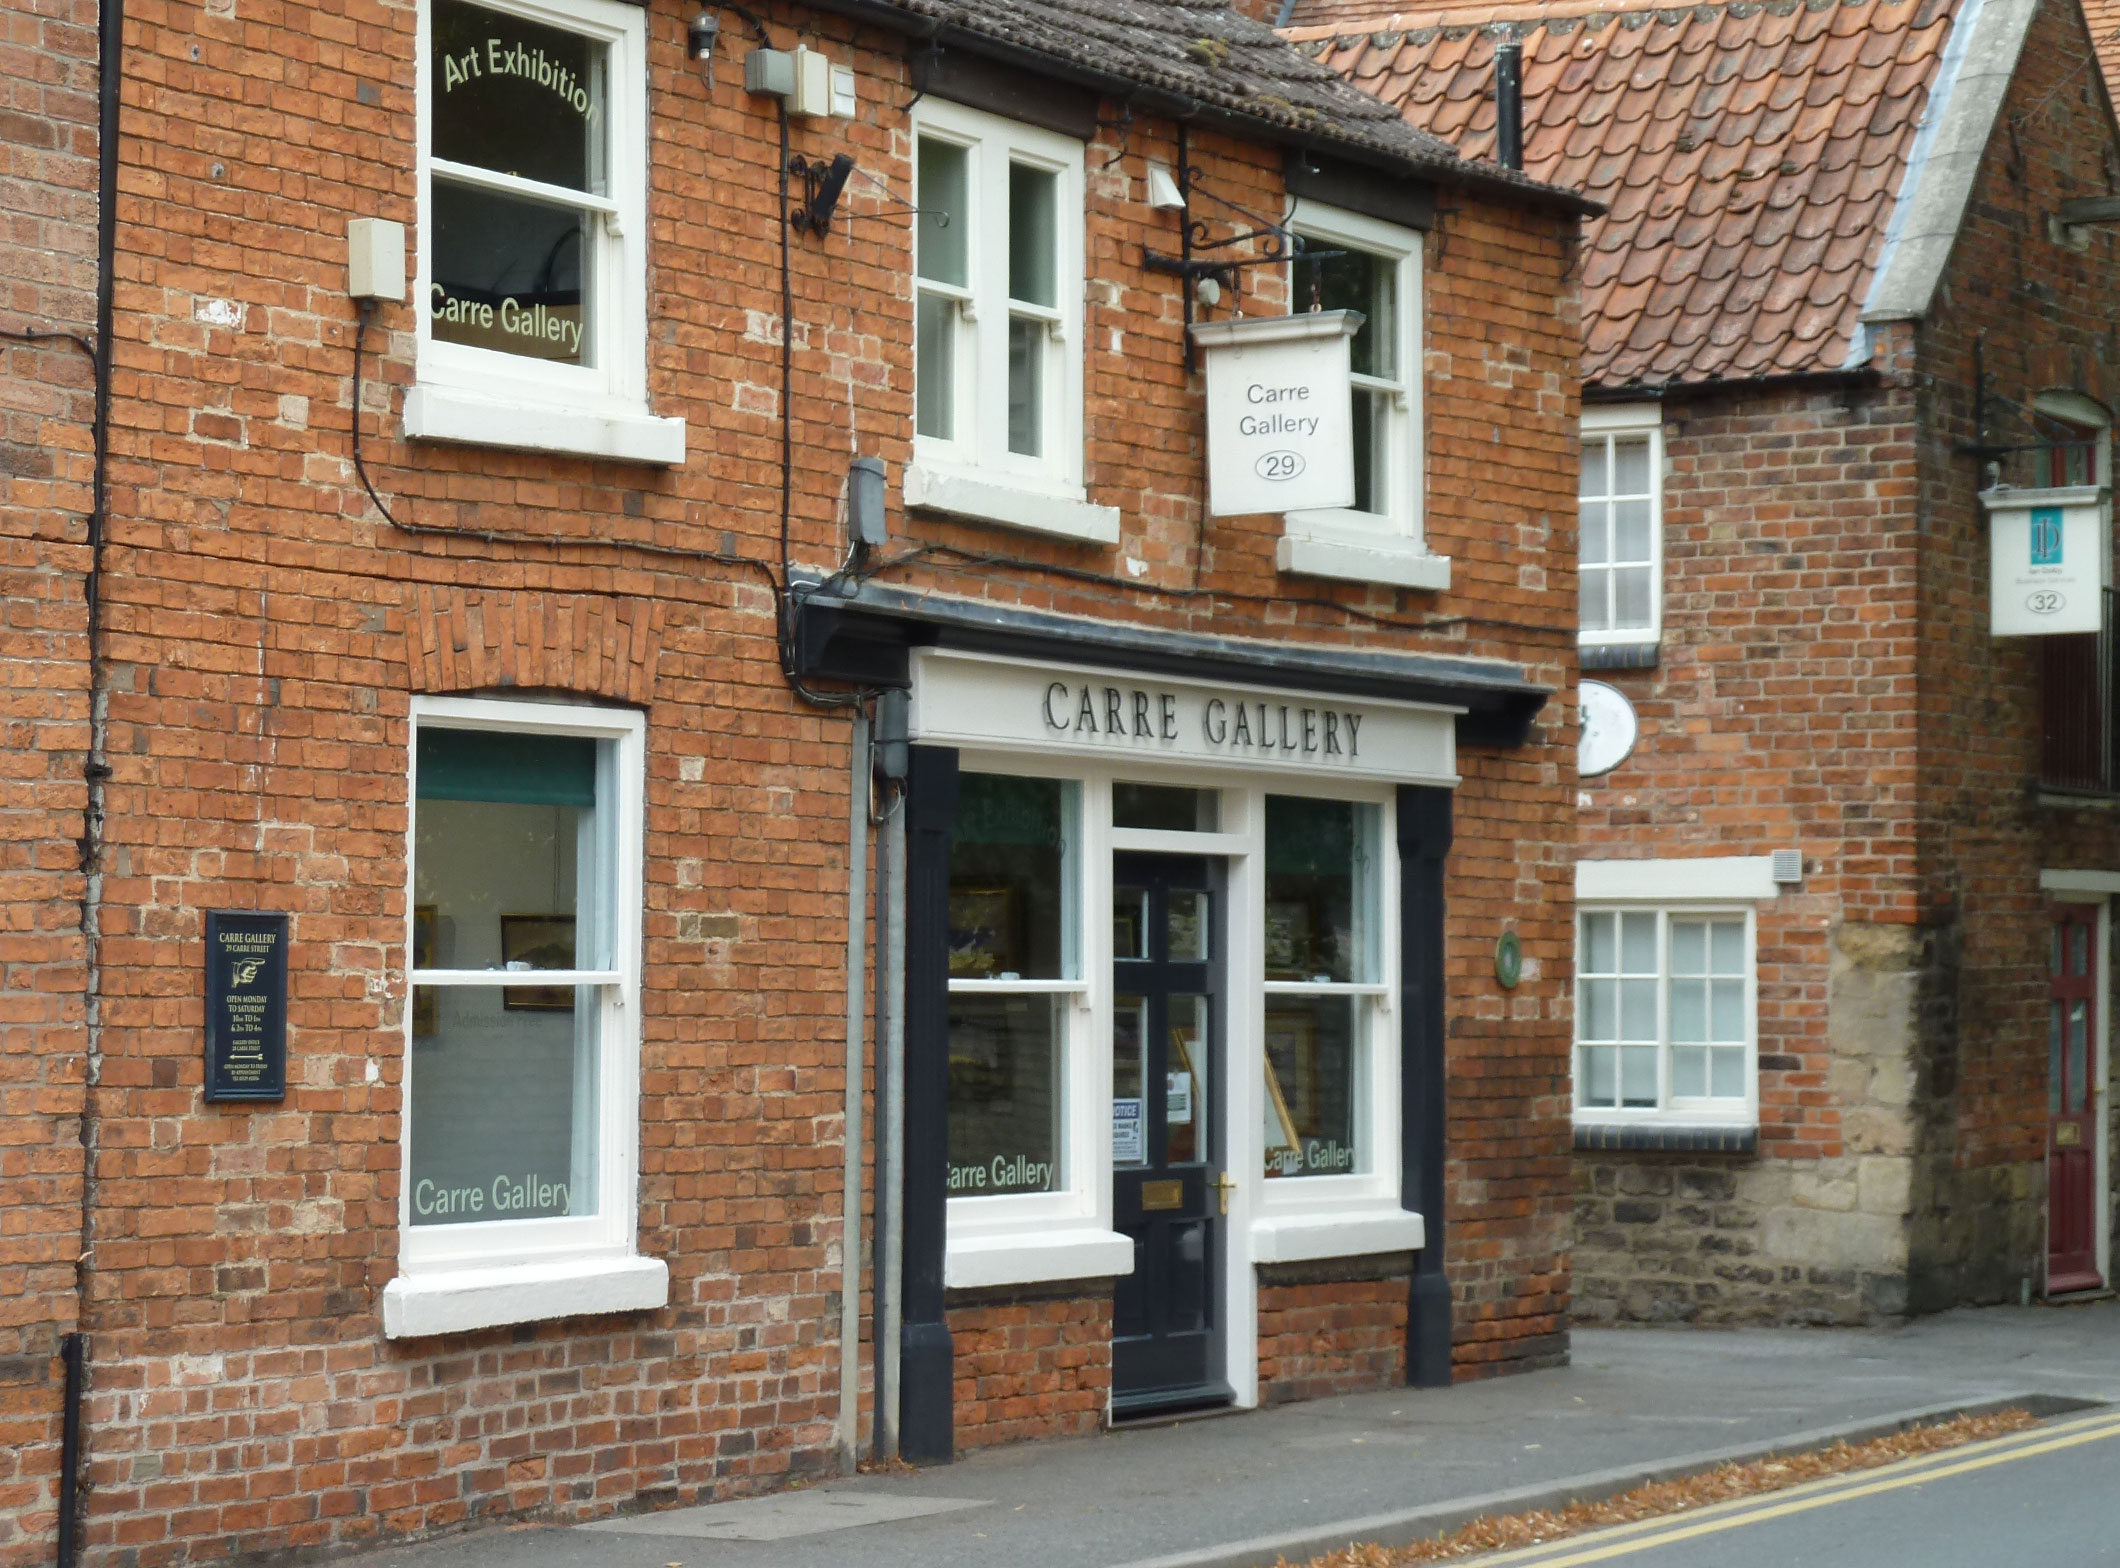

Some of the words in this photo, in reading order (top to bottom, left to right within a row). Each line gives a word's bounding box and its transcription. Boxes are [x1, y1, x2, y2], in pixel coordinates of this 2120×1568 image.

[444, 45, 482, 93] Art
[488, 38, 599, 129] Exhibition
[430, 282, 494, 329] Carre
[501, 296, 584, 353] Gallery
[1247, 383, 1310, 404] Carre
[1239, 413, 1320, 436] Gallery
[1266, 455, 1295, 476] 29
[2034, 593, 2058, 610] 32
[1045, 681, 1179, 741] CARRE
[1204, 698, 1364, 757] GALLERY
[219, 932, 244, 943] CARRE
[245, 932, 276, 944] GALLERY
[233, 944, 250, 952] CARRE
[251, 945, 270, 953] STREET
[226, 995, 242, 1003] OPEN
[243, 995, 268, 1003] MONDAY
[228, 1004, 237, 1013] TO
[238, 1004, 266, 1013] SATURDAY
[244, 1014, 253, 1022] TO
[245, 1023, 253, 1032] TO
[1308, 1140, 1353, 1170] Galler
[946, 1161, 987, 1190] arre
[991, 1154, 1054, 1191] Gallery
[415, 1178, 484, 1216] Carre
[491, 1173, 572, 1216] Gallery
